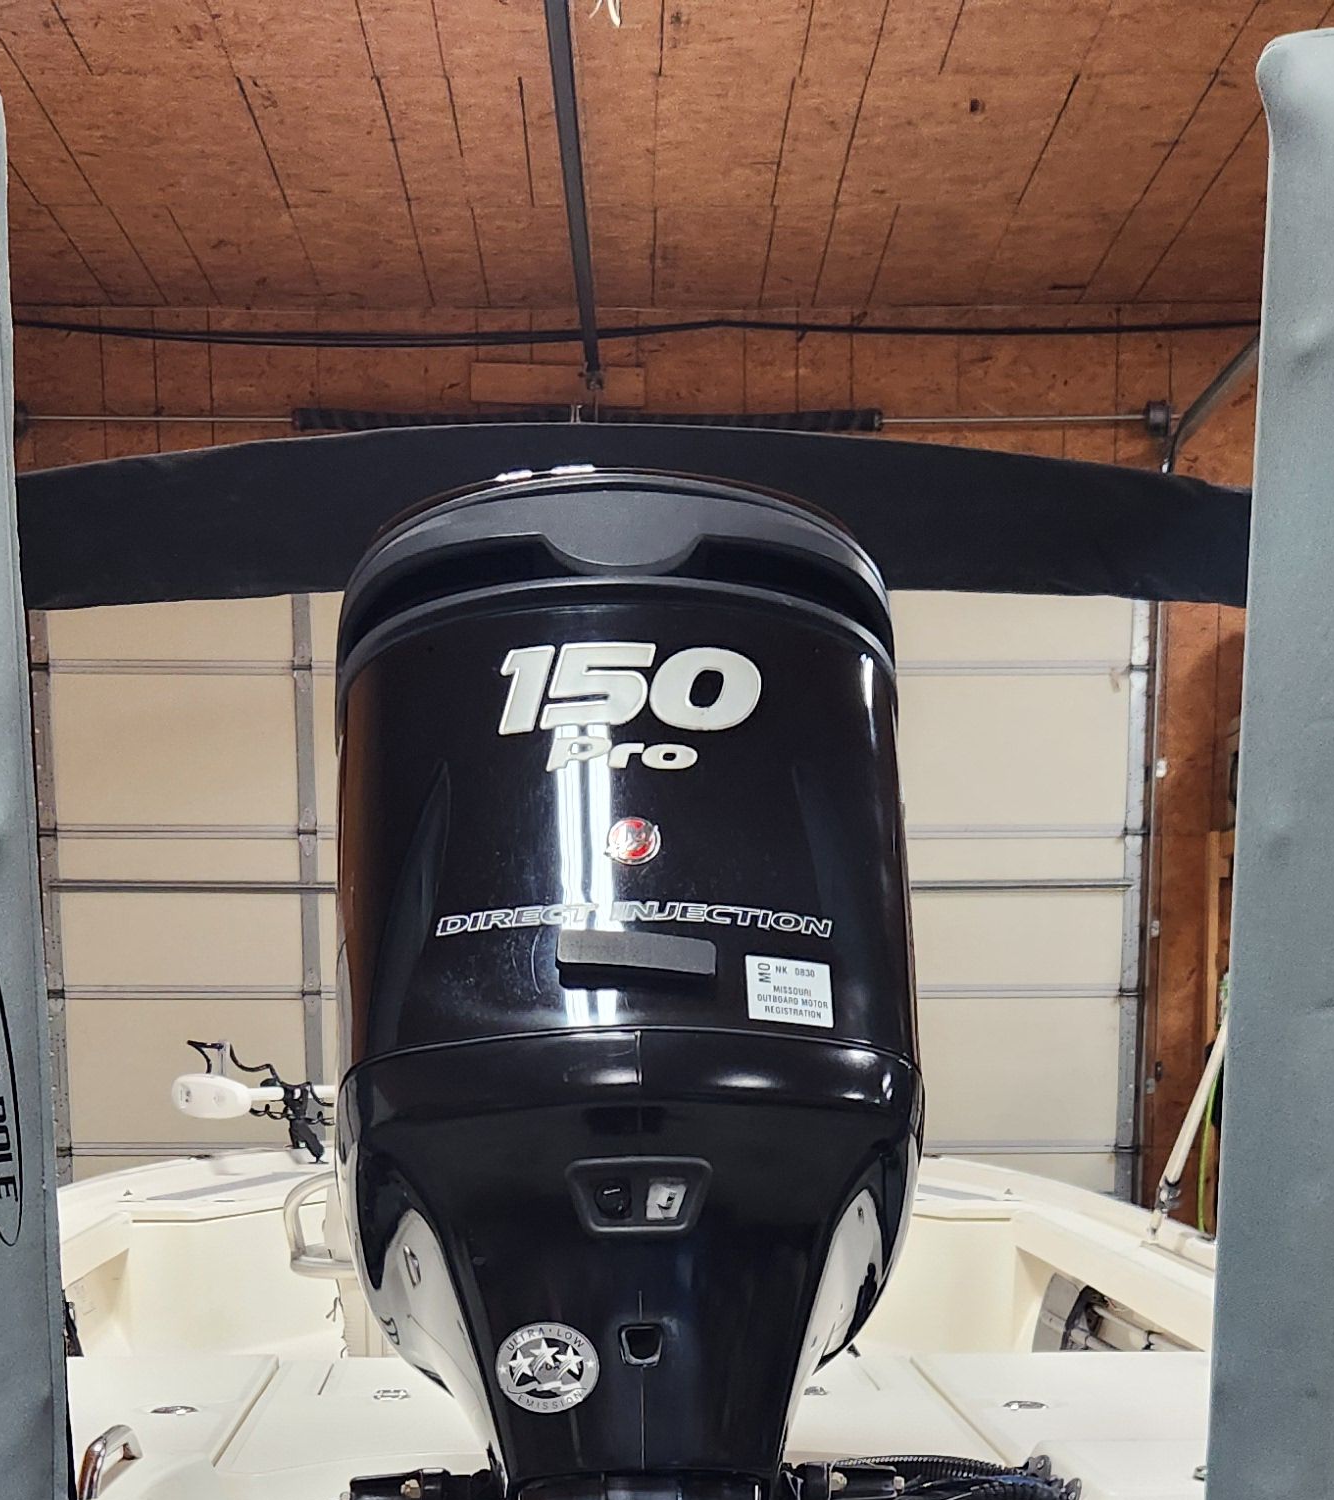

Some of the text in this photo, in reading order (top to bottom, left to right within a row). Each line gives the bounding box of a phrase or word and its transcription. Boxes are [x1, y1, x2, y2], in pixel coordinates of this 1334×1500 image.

[498, 641, 762, 735] 150
[545, 735, 699, 772] Pro
[436, 900, 832, 938] DIRECT INJECTION
[757, 962, 771, 984] MO
[775, 965, 788, 975] NK
[756, 993, 829, 1009] OUTBOARD MOTOR
[773, 984, 812, 998] MISSOURI
[764, 1005, 822, 1019] REGISTRATION
[506, 1326, 585, 1351] ULTRA LOW
[517, 1390, 583, 1411] EMISSION
